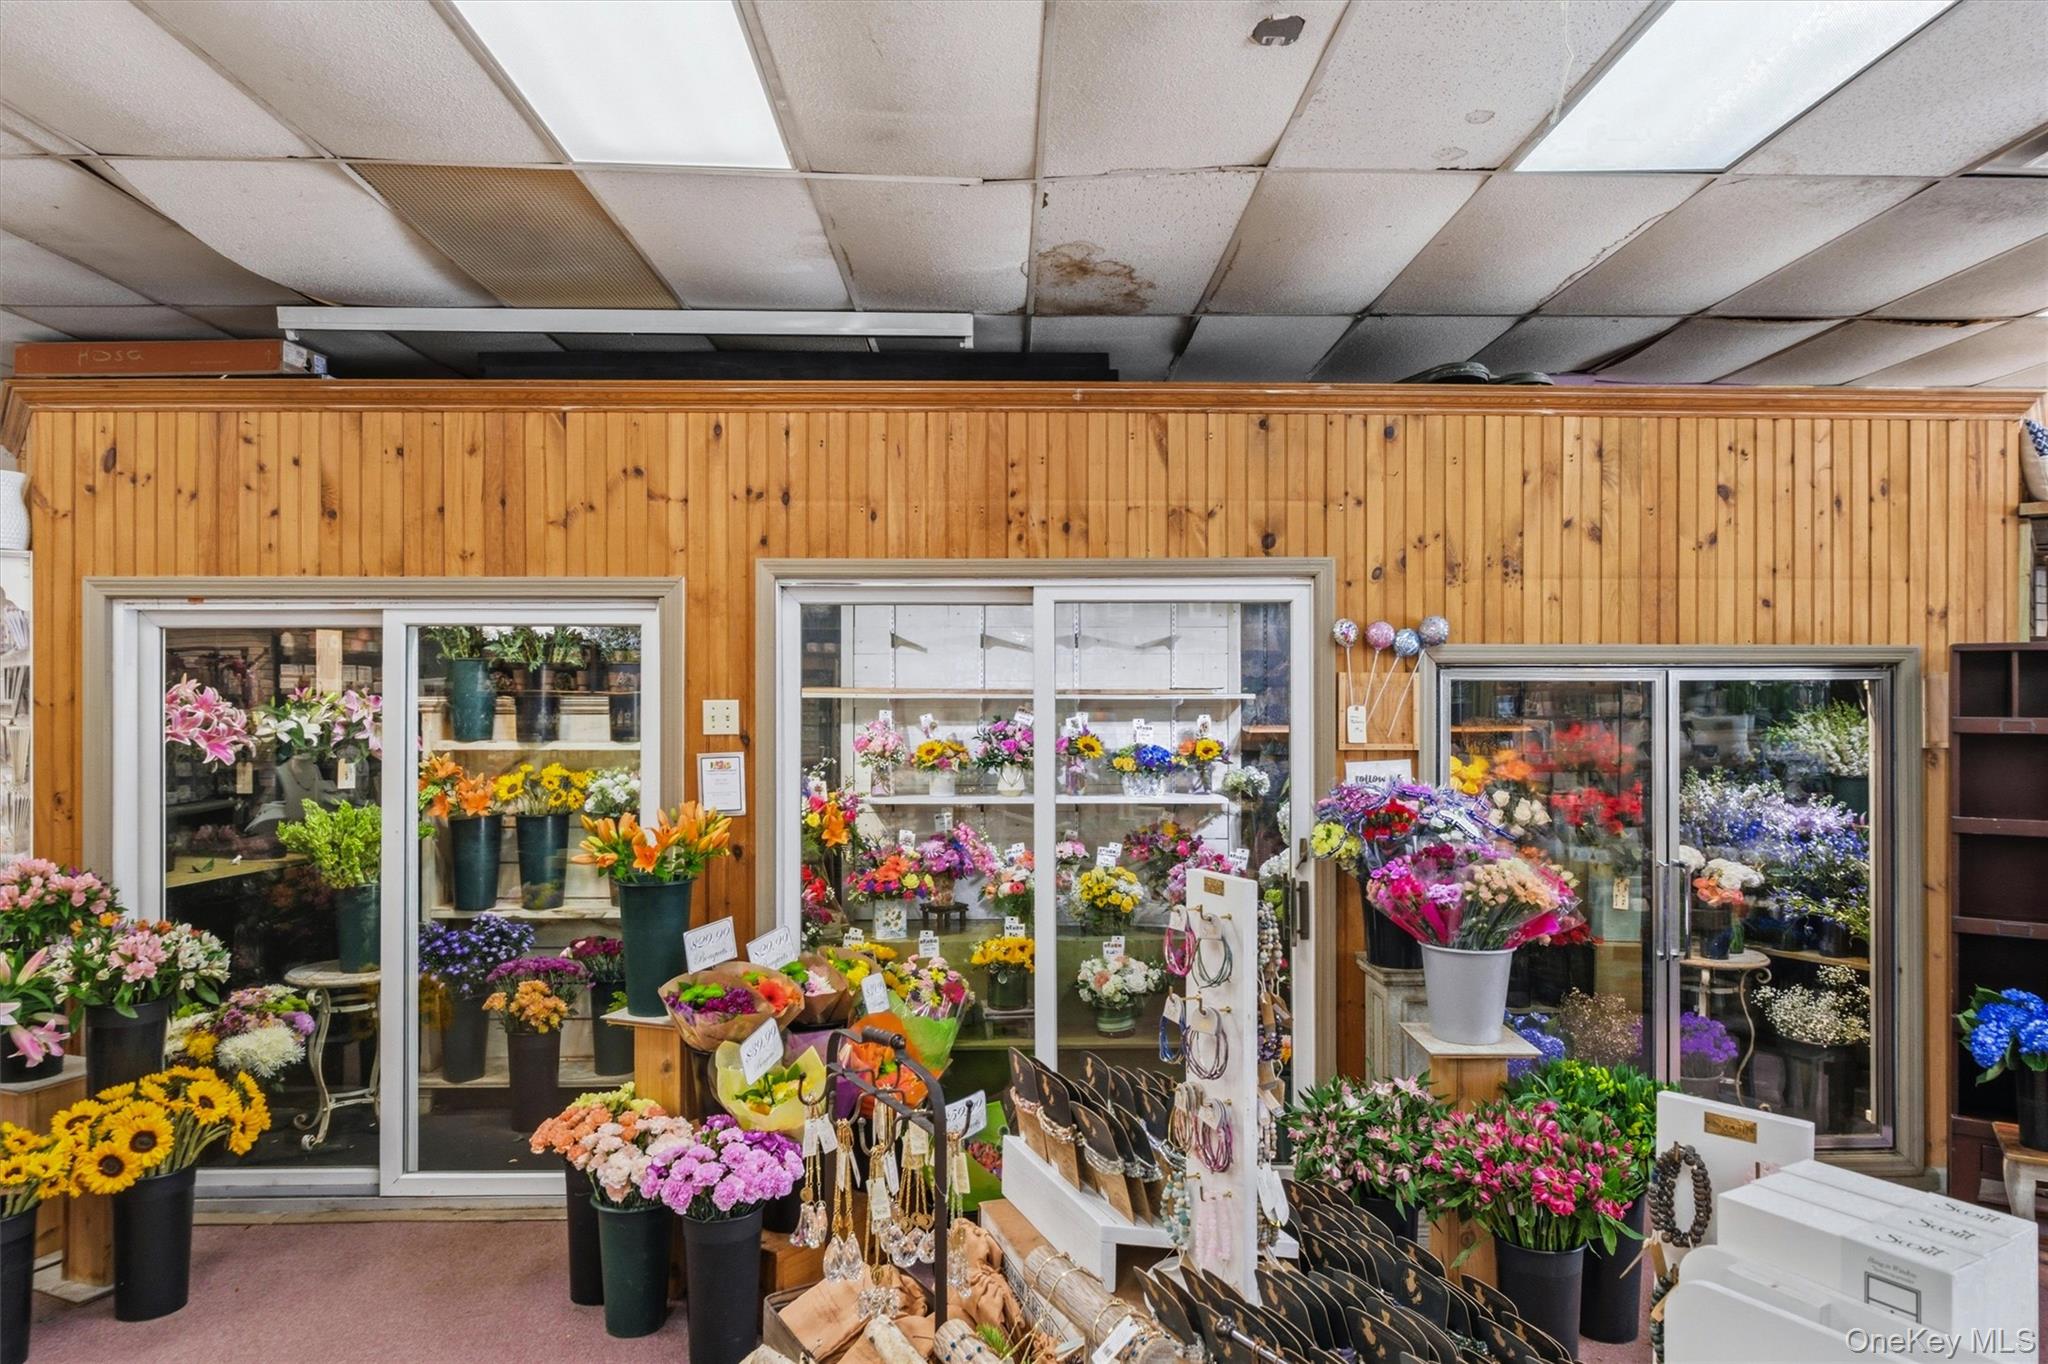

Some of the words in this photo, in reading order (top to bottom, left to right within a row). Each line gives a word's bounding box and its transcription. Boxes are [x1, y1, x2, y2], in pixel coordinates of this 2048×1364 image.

[1934, 1202, 2004, 1223] Scout
[1908, 1218, 1981, 1241] Scout
[1875, 1233, 1949, 1257] Scout
